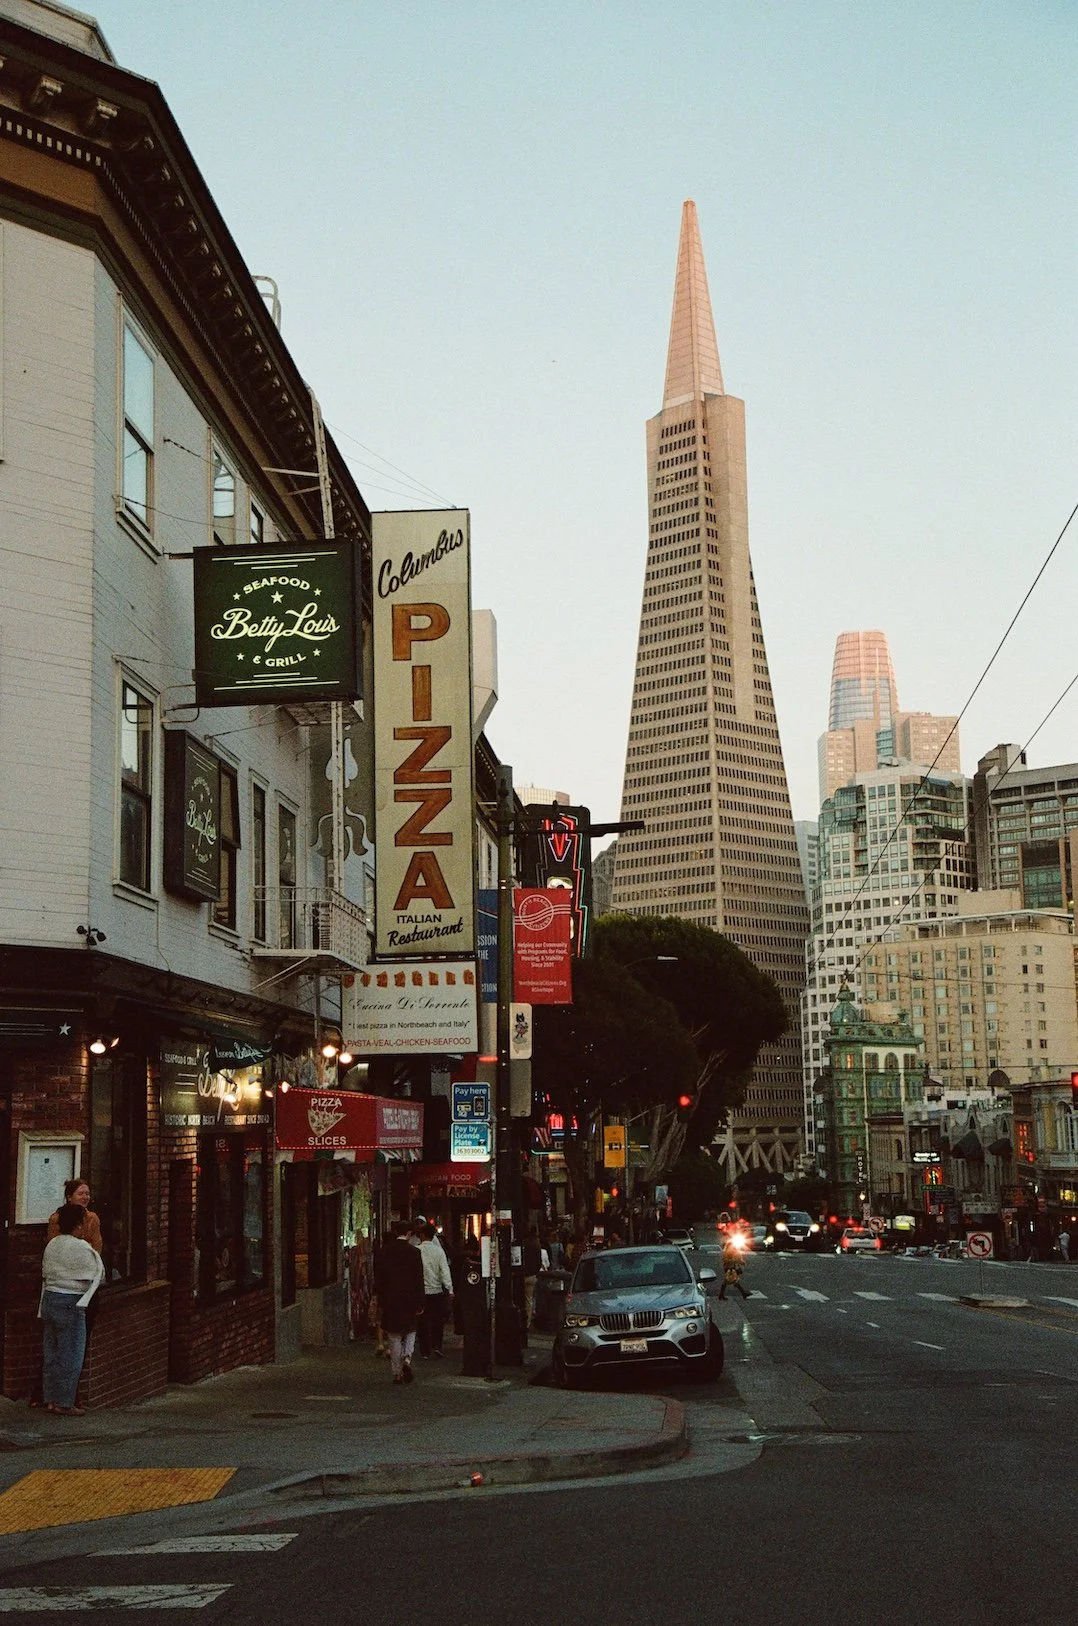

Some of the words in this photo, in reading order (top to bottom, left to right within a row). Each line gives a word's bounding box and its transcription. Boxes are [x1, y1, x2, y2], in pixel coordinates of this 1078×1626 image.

[378, 529, 464, 599] Columbus
[243, 576, 310, 595] SEAFOOD
[210, 608, 285, 652] Betty
[252, 656, 260, 665] &
[265, 652, 306, 668] GRILL
[392, 602, 456, 911] PIZZA
[396, 914, 442, 924] ITALIAN
[387, 917, 463, 947] Restaurant
[439, 1020, 451, 1028] and
[455, 1087, 469, 1096] Pay
[311, 1098, 342, 1107] PIZZA
[455, 1125, 468, 1134] Pay
[469, 1125, 478, 1133] by
[308, 1136, 346, 1146] SLICES
